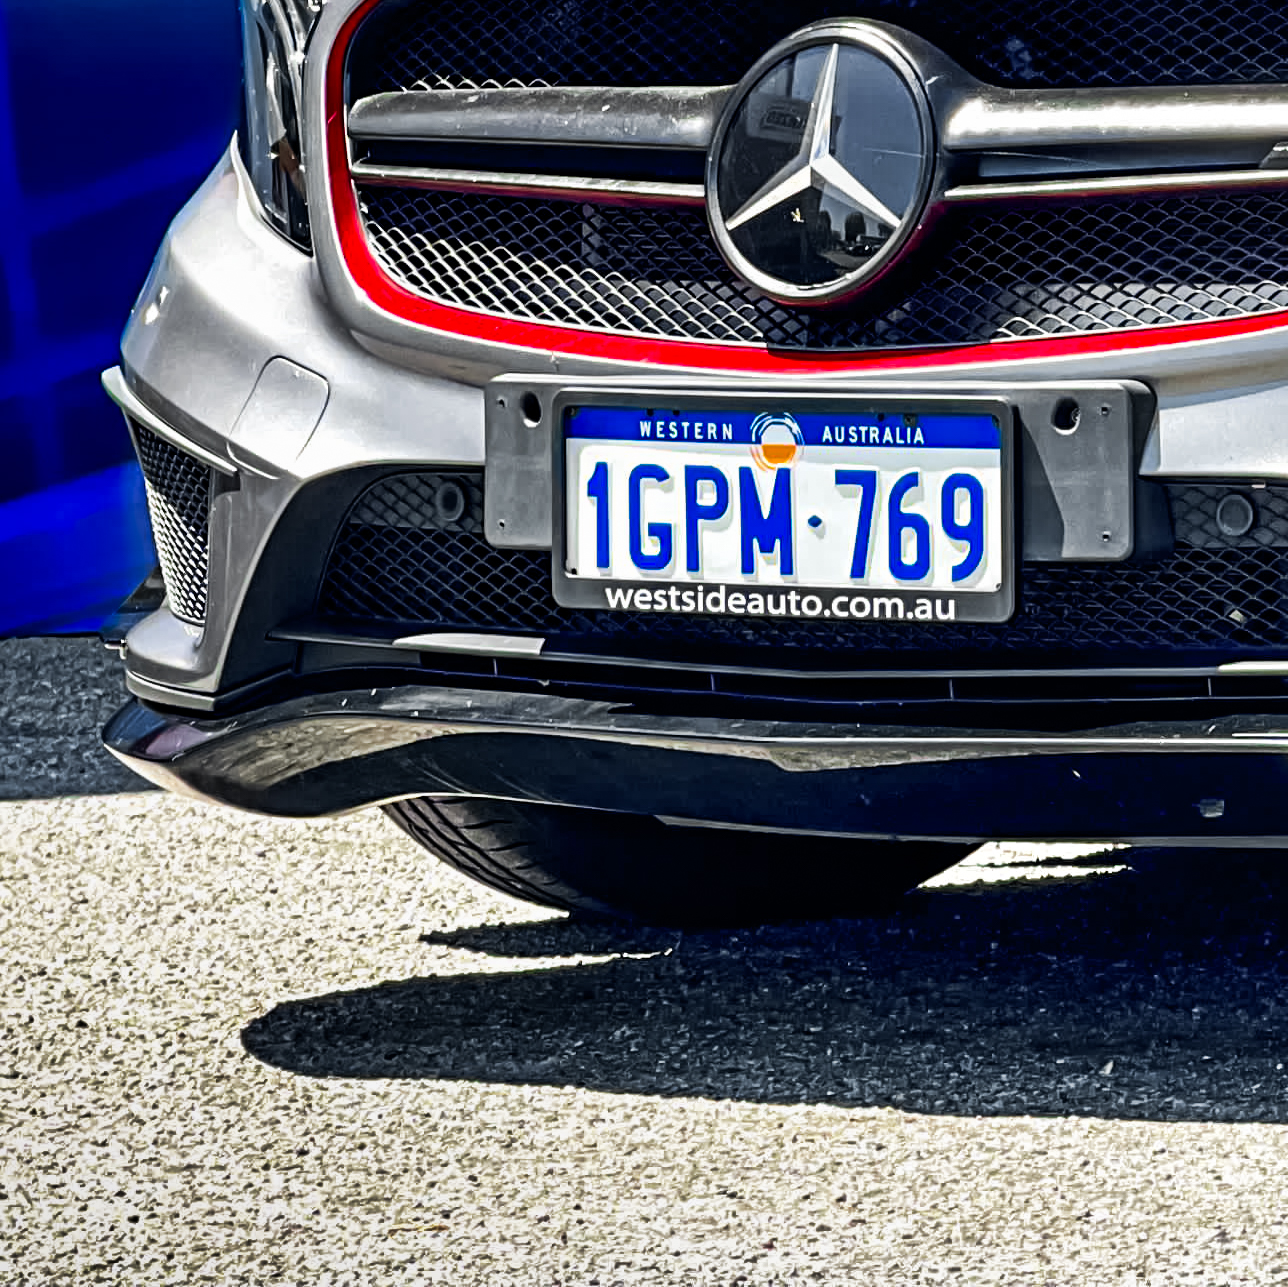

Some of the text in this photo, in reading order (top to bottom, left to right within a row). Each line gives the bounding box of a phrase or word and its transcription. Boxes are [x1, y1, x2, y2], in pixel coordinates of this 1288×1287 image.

[639, 420, 925, 445] WESTERN AUSTRALIA
[604, 585, 956, 621] westsideauto.com.au
